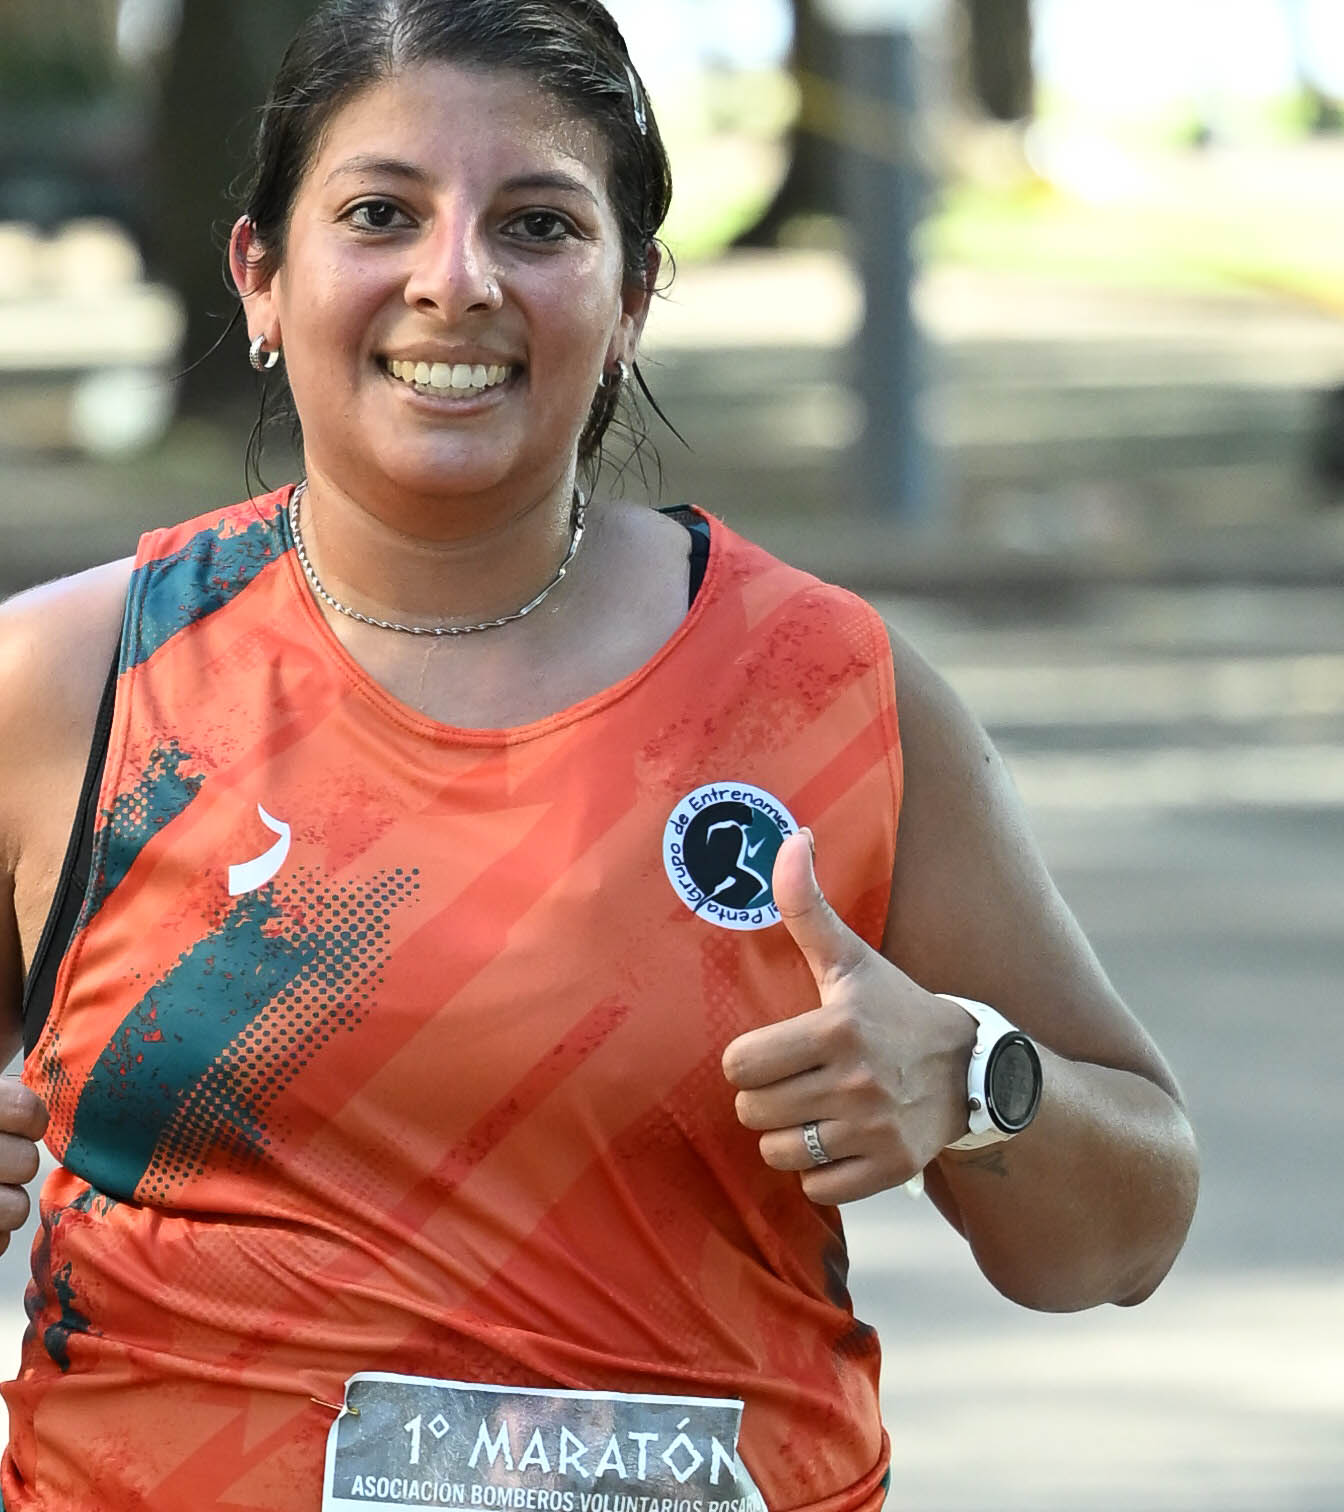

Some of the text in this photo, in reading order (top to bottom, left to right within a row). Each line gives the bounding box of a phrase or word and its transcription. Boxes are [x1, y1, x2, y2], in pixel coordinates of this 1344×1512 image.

[670, 813, 689, 835] de
[671, 843, 702, 902] Grupo
[707, 902, 763, 923] Penta
[467, 1417, 739, 1485] MARATÓN
[351, 1474, 465, 1503] ASOCIACIÓN
[471, 1484, 574, 1512] BOMBEROS
